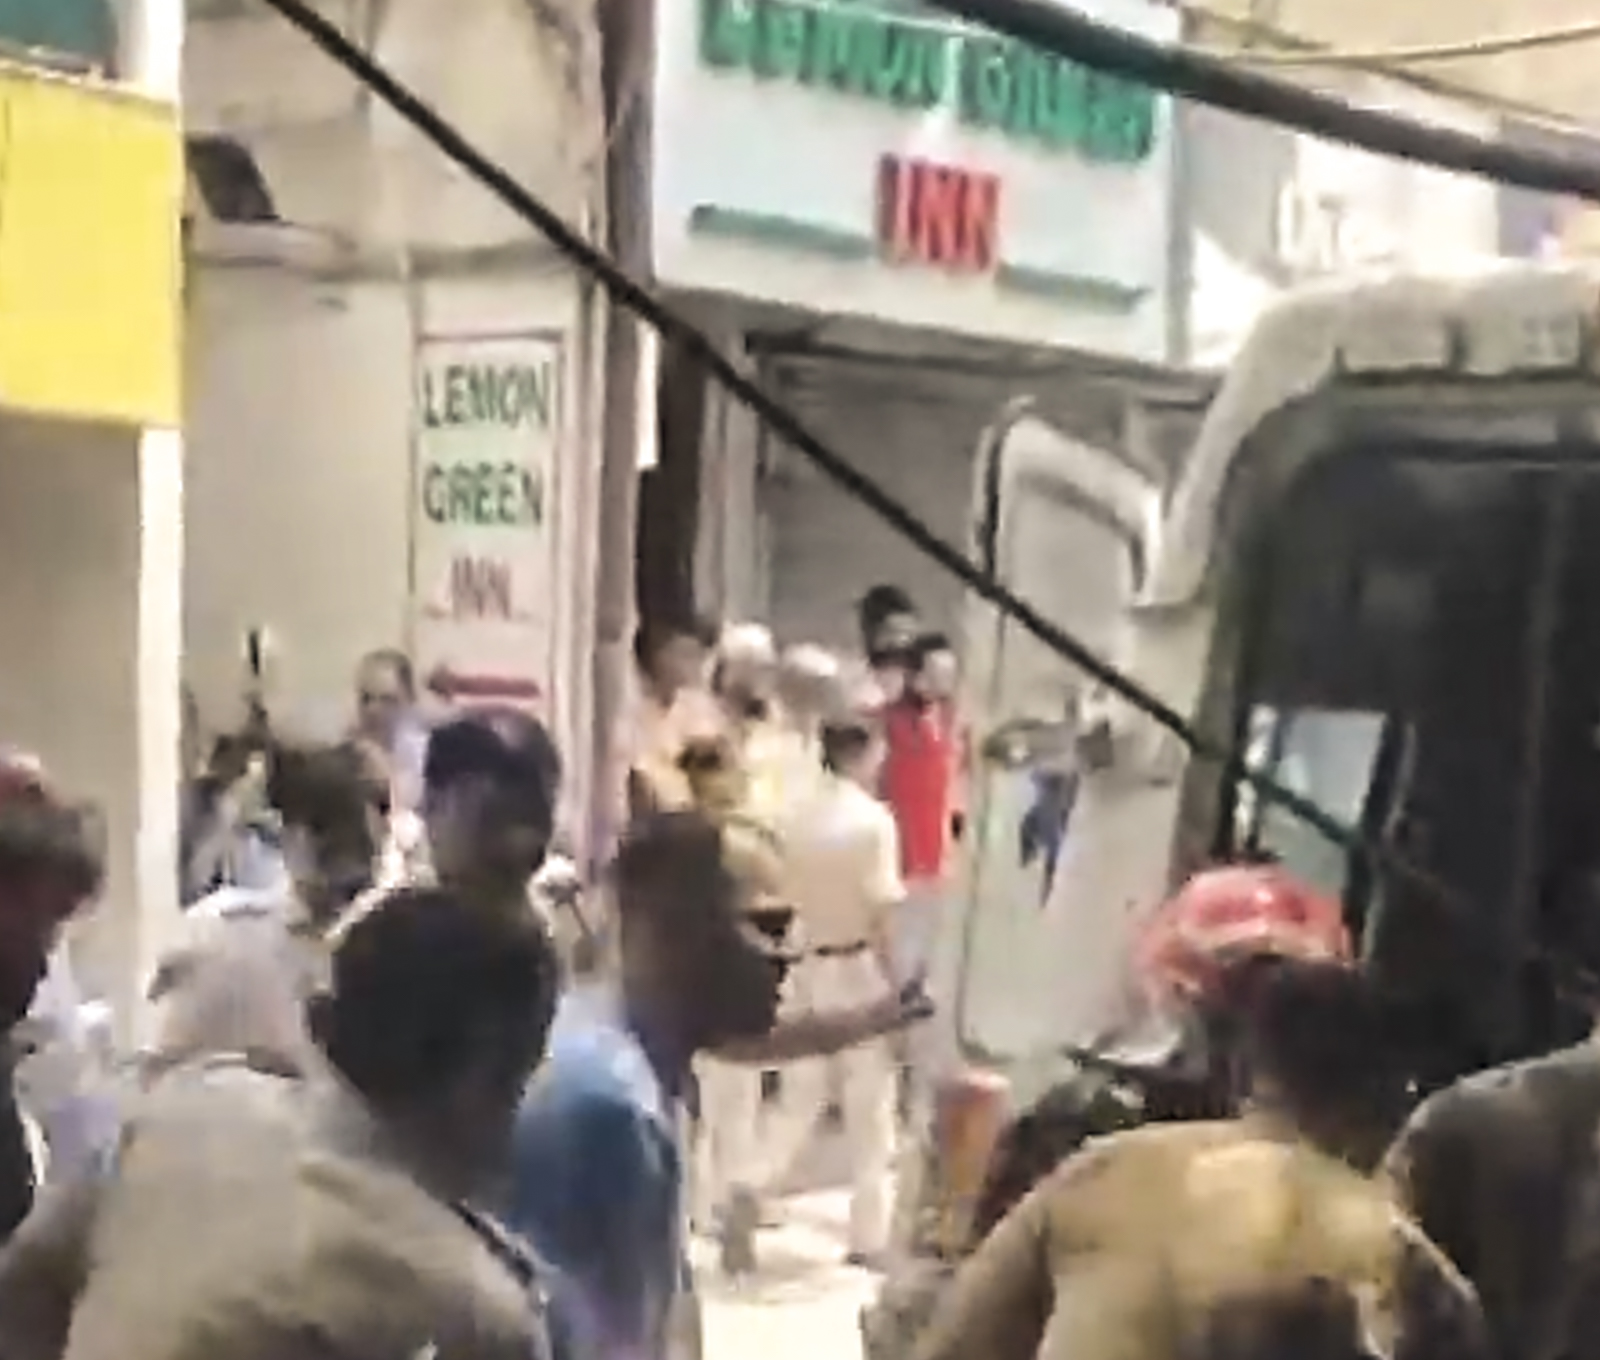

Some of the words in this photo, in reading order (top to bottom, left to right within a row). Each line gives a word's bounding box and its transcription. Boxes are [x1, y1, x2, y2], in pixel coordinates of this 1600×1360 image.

[875, 152, 1000, 271] INN
[423, 362, 550, 428] LEMON
[423, 460, 543, 526] GREEN
[450, 556, 513, 622] INN
